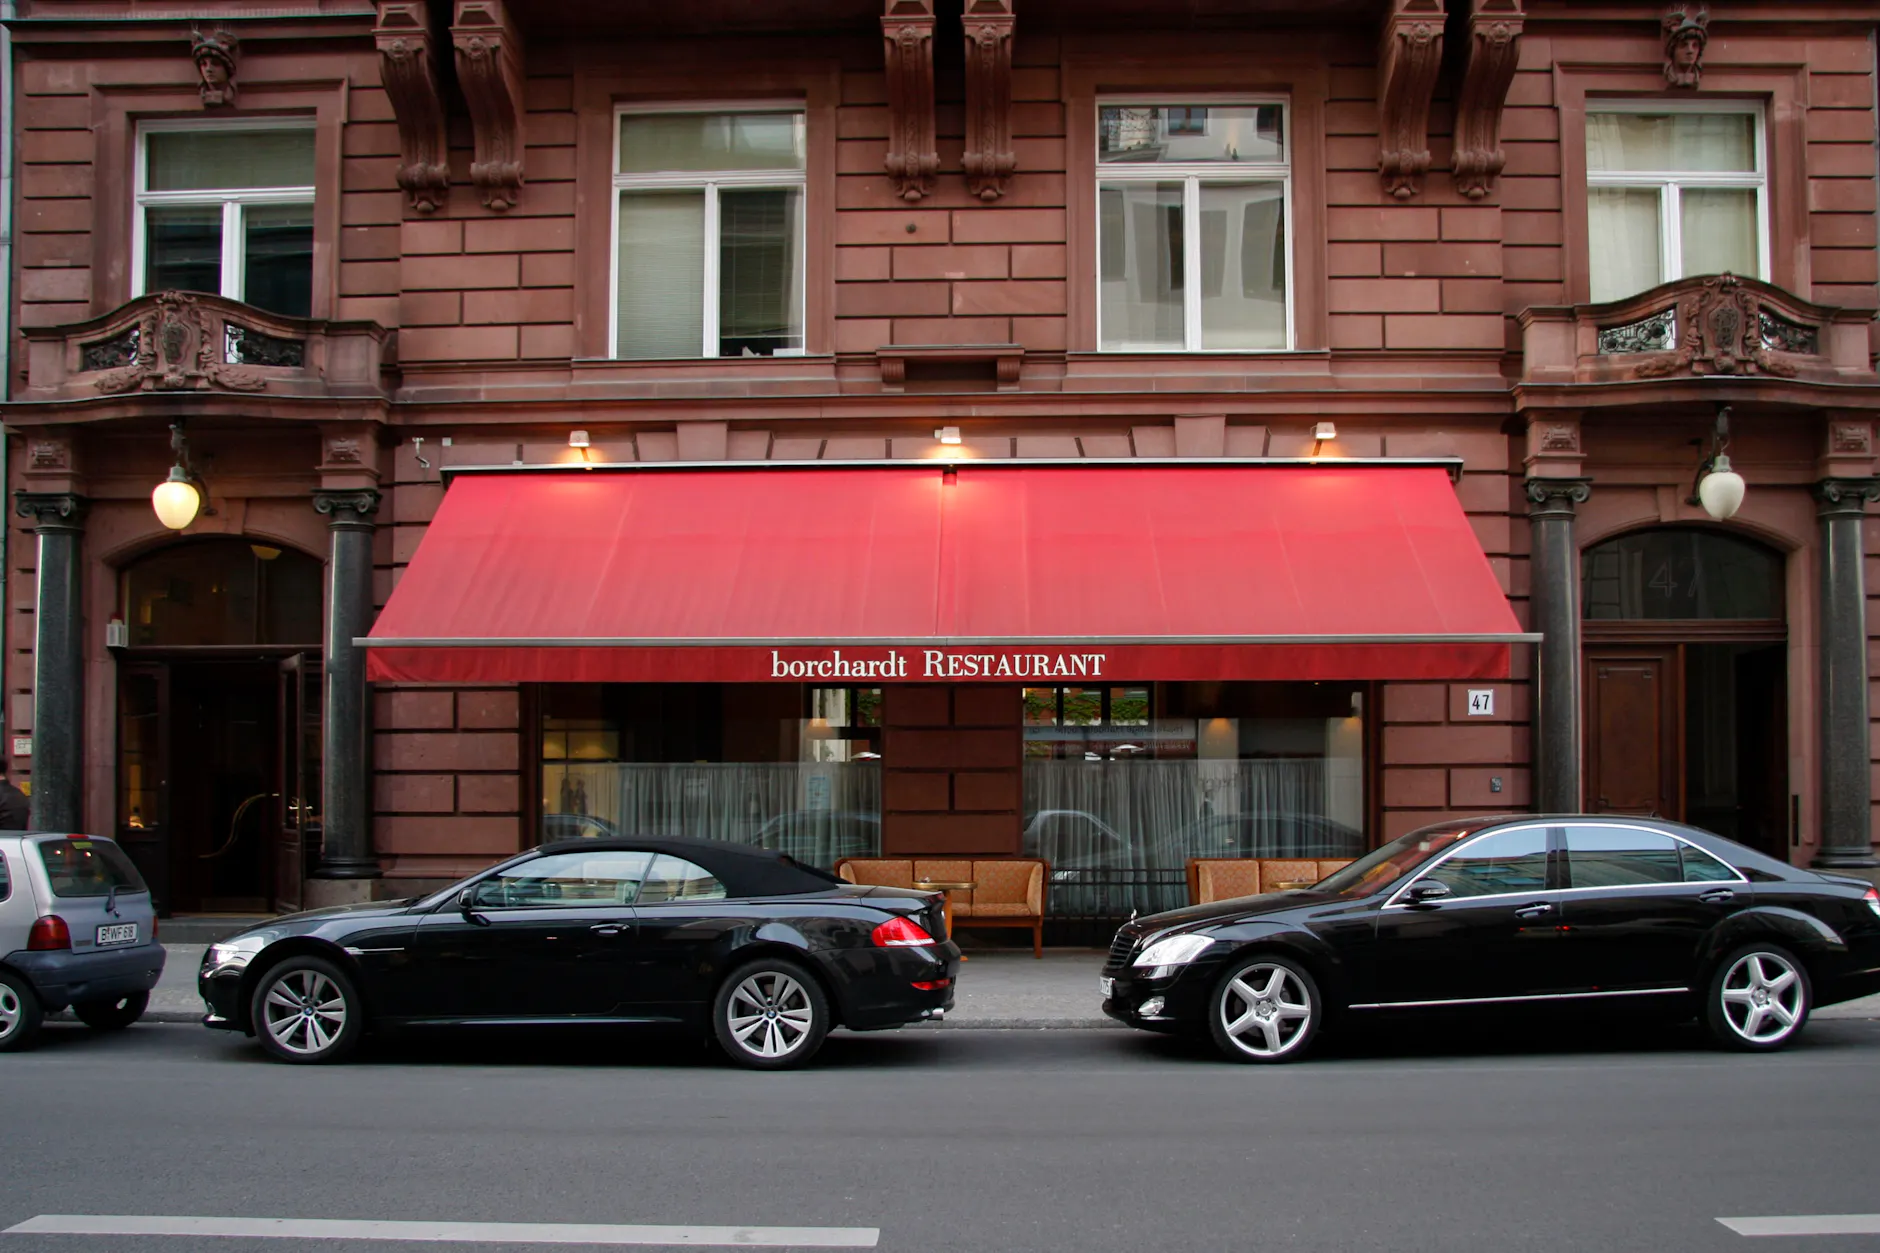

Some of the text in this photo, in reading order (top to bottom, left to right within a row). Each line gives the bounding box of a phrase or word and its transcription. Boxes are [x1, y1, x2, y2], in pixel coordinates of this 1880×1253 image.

[770, 649, 1106, 677] borchardt RESTAURANT
[1472, 694, 1490, 710] 47
